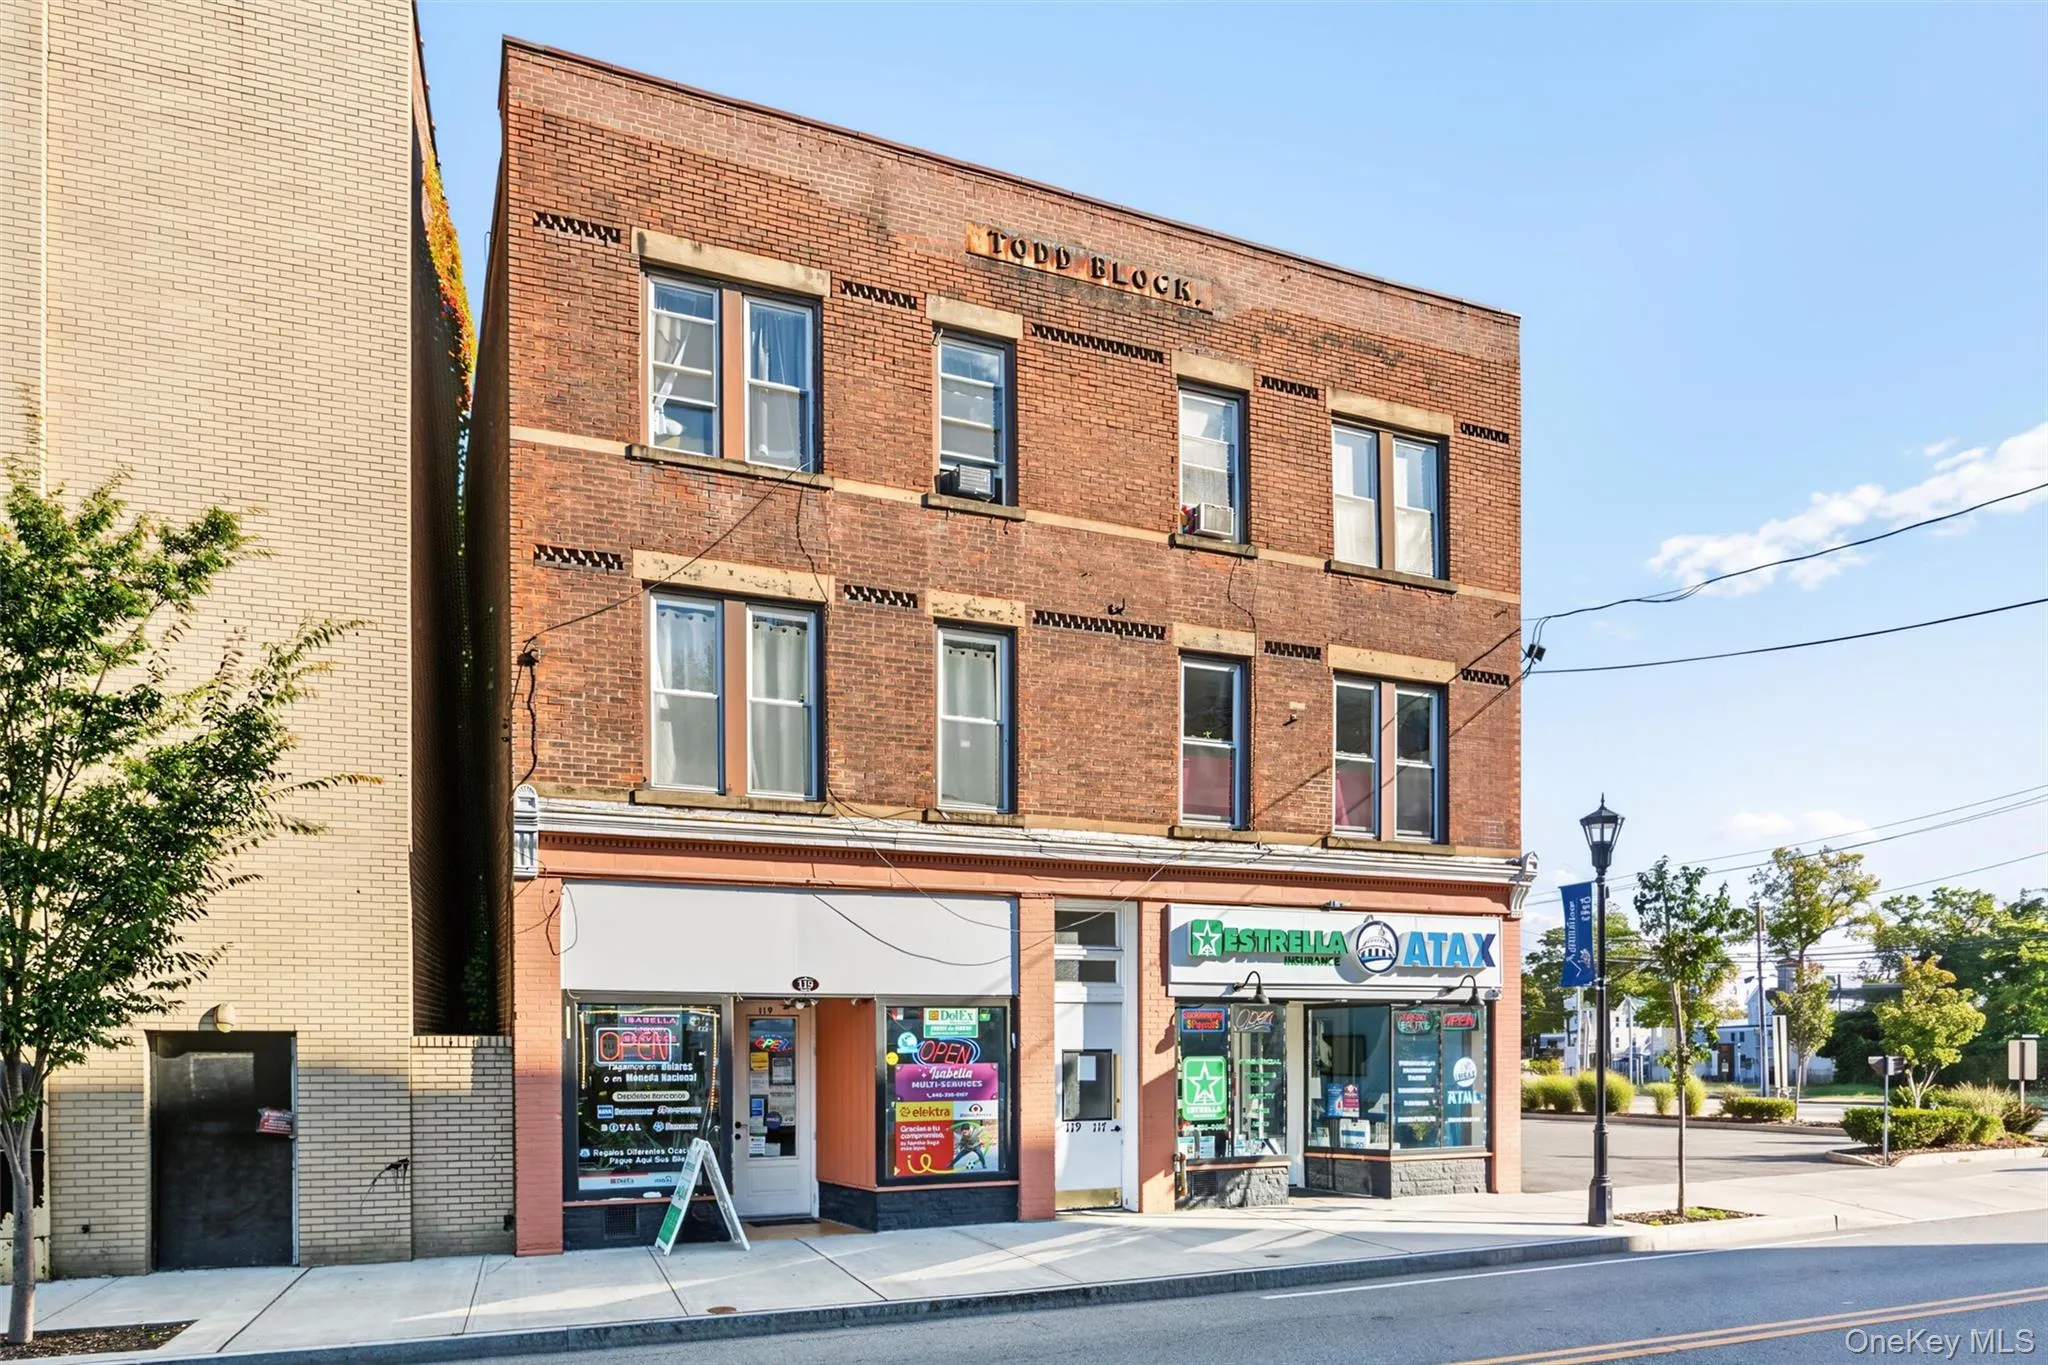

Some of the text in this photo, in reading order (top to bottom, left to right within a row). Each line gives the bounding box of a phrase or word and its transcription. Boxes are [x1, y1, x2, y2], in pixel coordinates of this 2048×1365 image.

[987, 230, 1200, 307] TODD BLOCK.
[1223, 927, 1348, 954] ESTRELLA
[1403, 931, 1497, 968] ATAX
[1284, 956, 1341, 967] INSURANCE
[798, 979, 814, 989] 119
[758, 1007, 773, 1015] 119
[940, 1010, 973, 1022] DolEx
[623, 1017, 676, 1025] ISABELLA
[600, 1031, 668, 1061] OPEN
[919, 1040, 971, 1065] OPEN
[930, 1066, 973, 1080] Isabella
[911, 1080, 983, 1089] MULTI-SERVICES
[912, 1107, 950, 1117] elektra
[900, 1125, 926, 1133] Gracias
[1065, 1122, 1107, 1133] 119 117
[593, 1149, 624, 1157] Regalos
[609, 1157, 633, 1165] Pague
